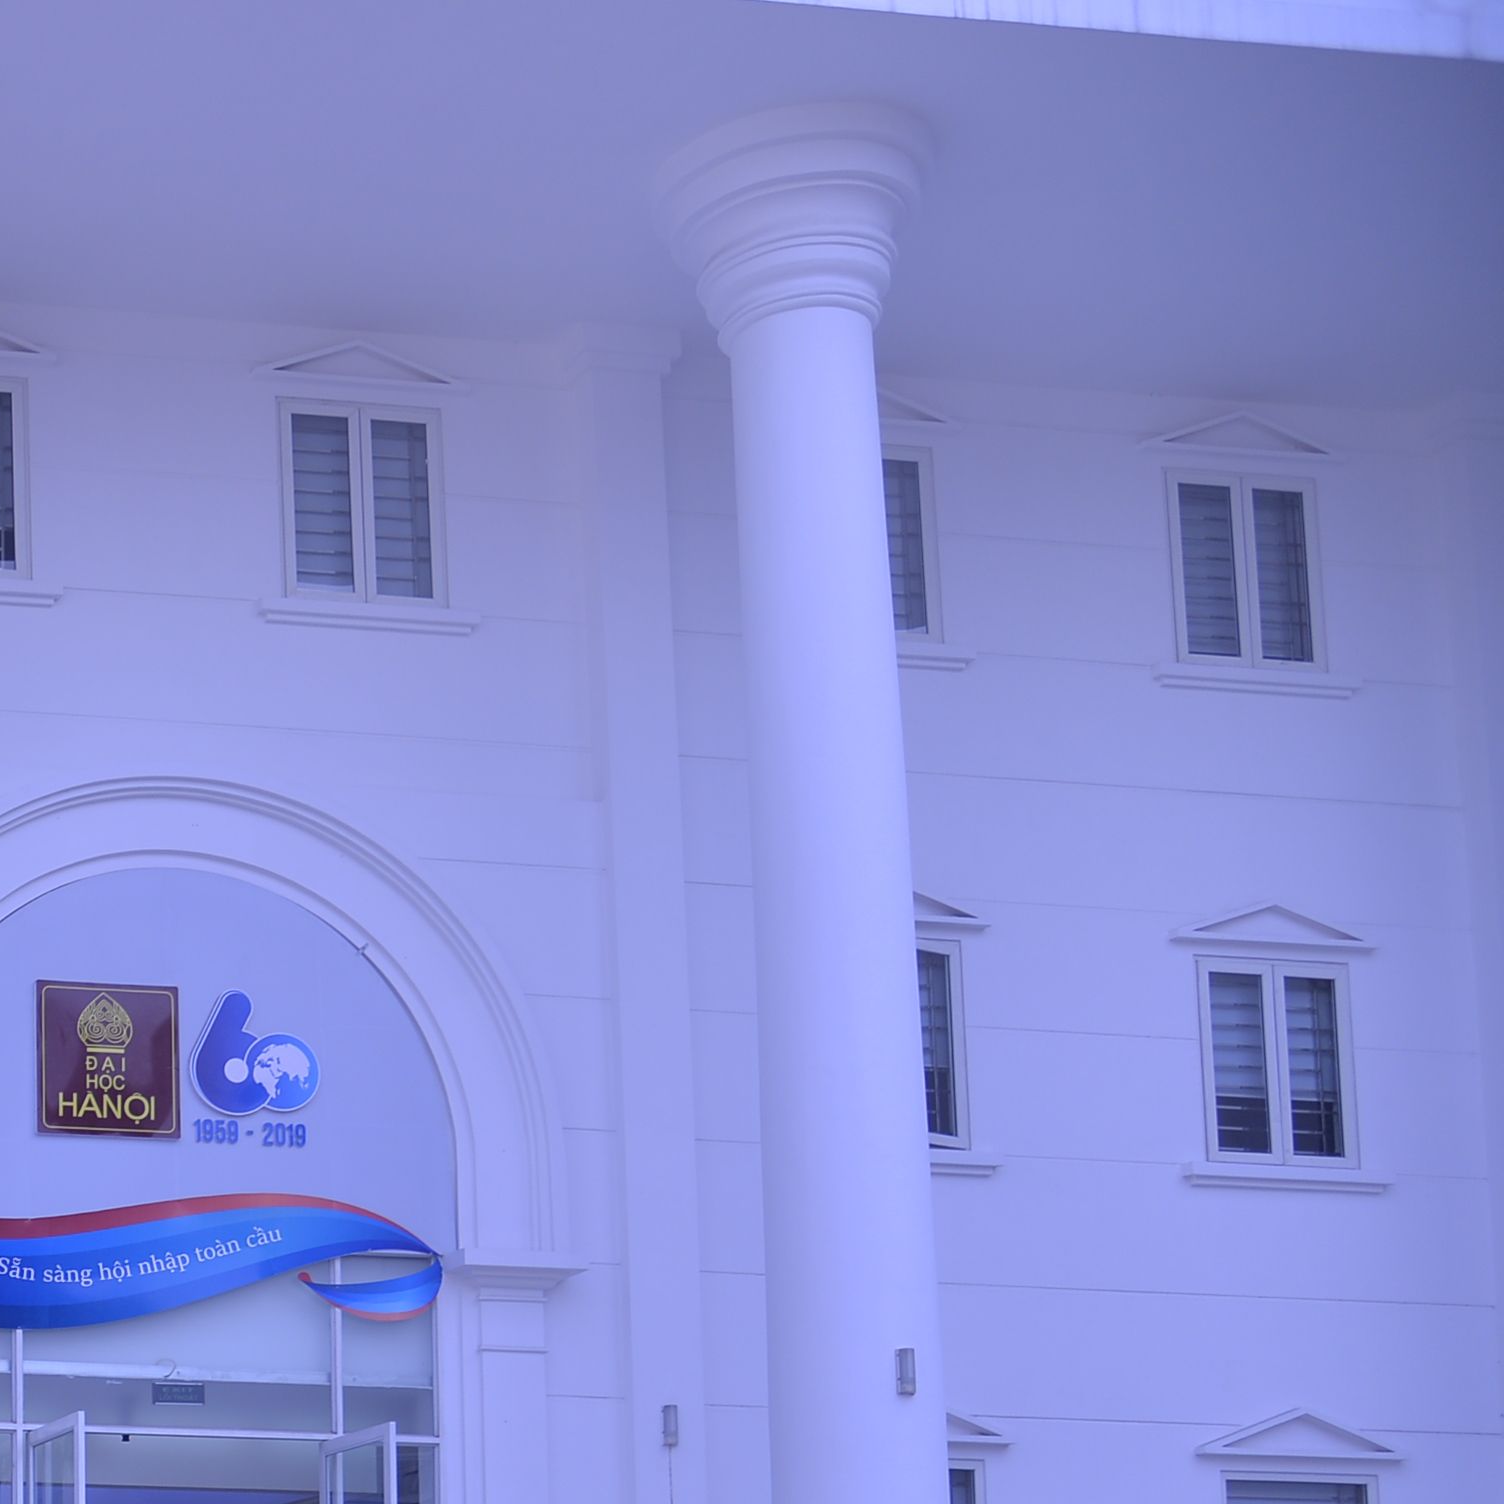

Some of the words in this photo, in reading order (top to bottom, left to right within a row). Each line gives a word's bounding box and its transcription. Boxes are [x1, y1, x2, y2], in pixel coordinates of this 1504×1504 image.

[86, 1074, 125, 1092] HỌC
[192, 1119, 238, 1144] 1959
[262, 1122, 307, 1148] 2019
[43, 1262, 93, 1287] sàng
[99, 1260, 132, 1283] hội
[138, 1252, 190, 1276] nhập
[195, 1239, 241, 1263] toàn
[246, 1227, 283, 1248] cầu
